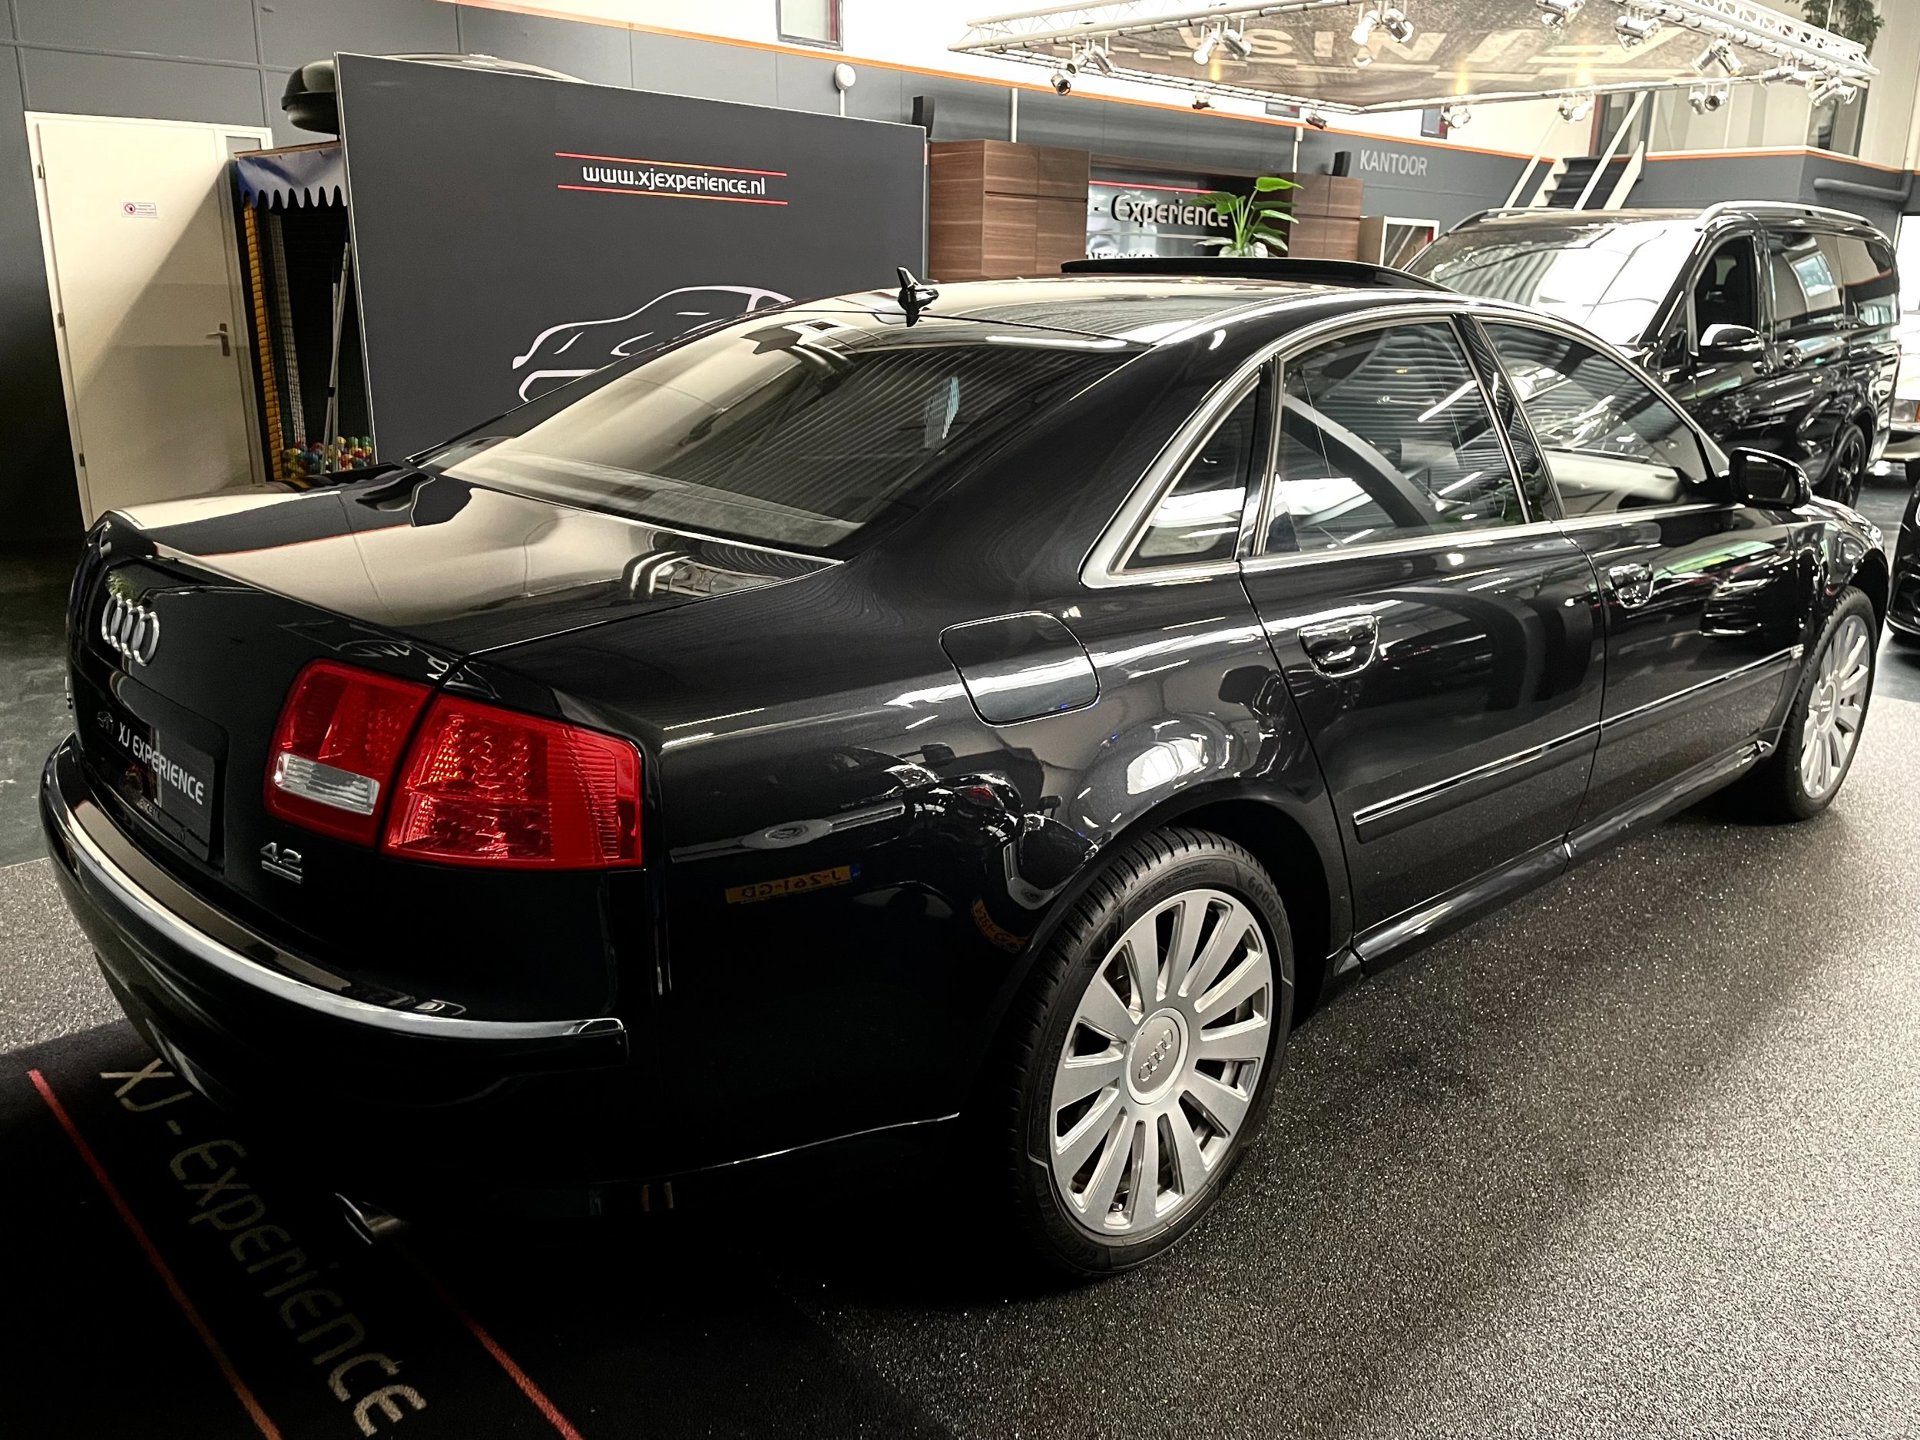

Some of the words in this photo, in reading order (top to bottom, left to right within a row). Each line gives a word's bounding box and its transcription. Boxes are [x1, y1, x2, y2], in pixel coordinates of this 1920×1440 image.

[1360, 149, 1428, 176] KANTOOR
[582, 166, 766, 195] www.xjexperience.nl
[1111, 194, 1229, 227] Experience
[118, 721, 131, 748] XJ
[132, 735, 204, 805] EXPERIENCE
[100, 1058, 193, 1112] XJ
[169, 1139, 427, 1437] Experience
